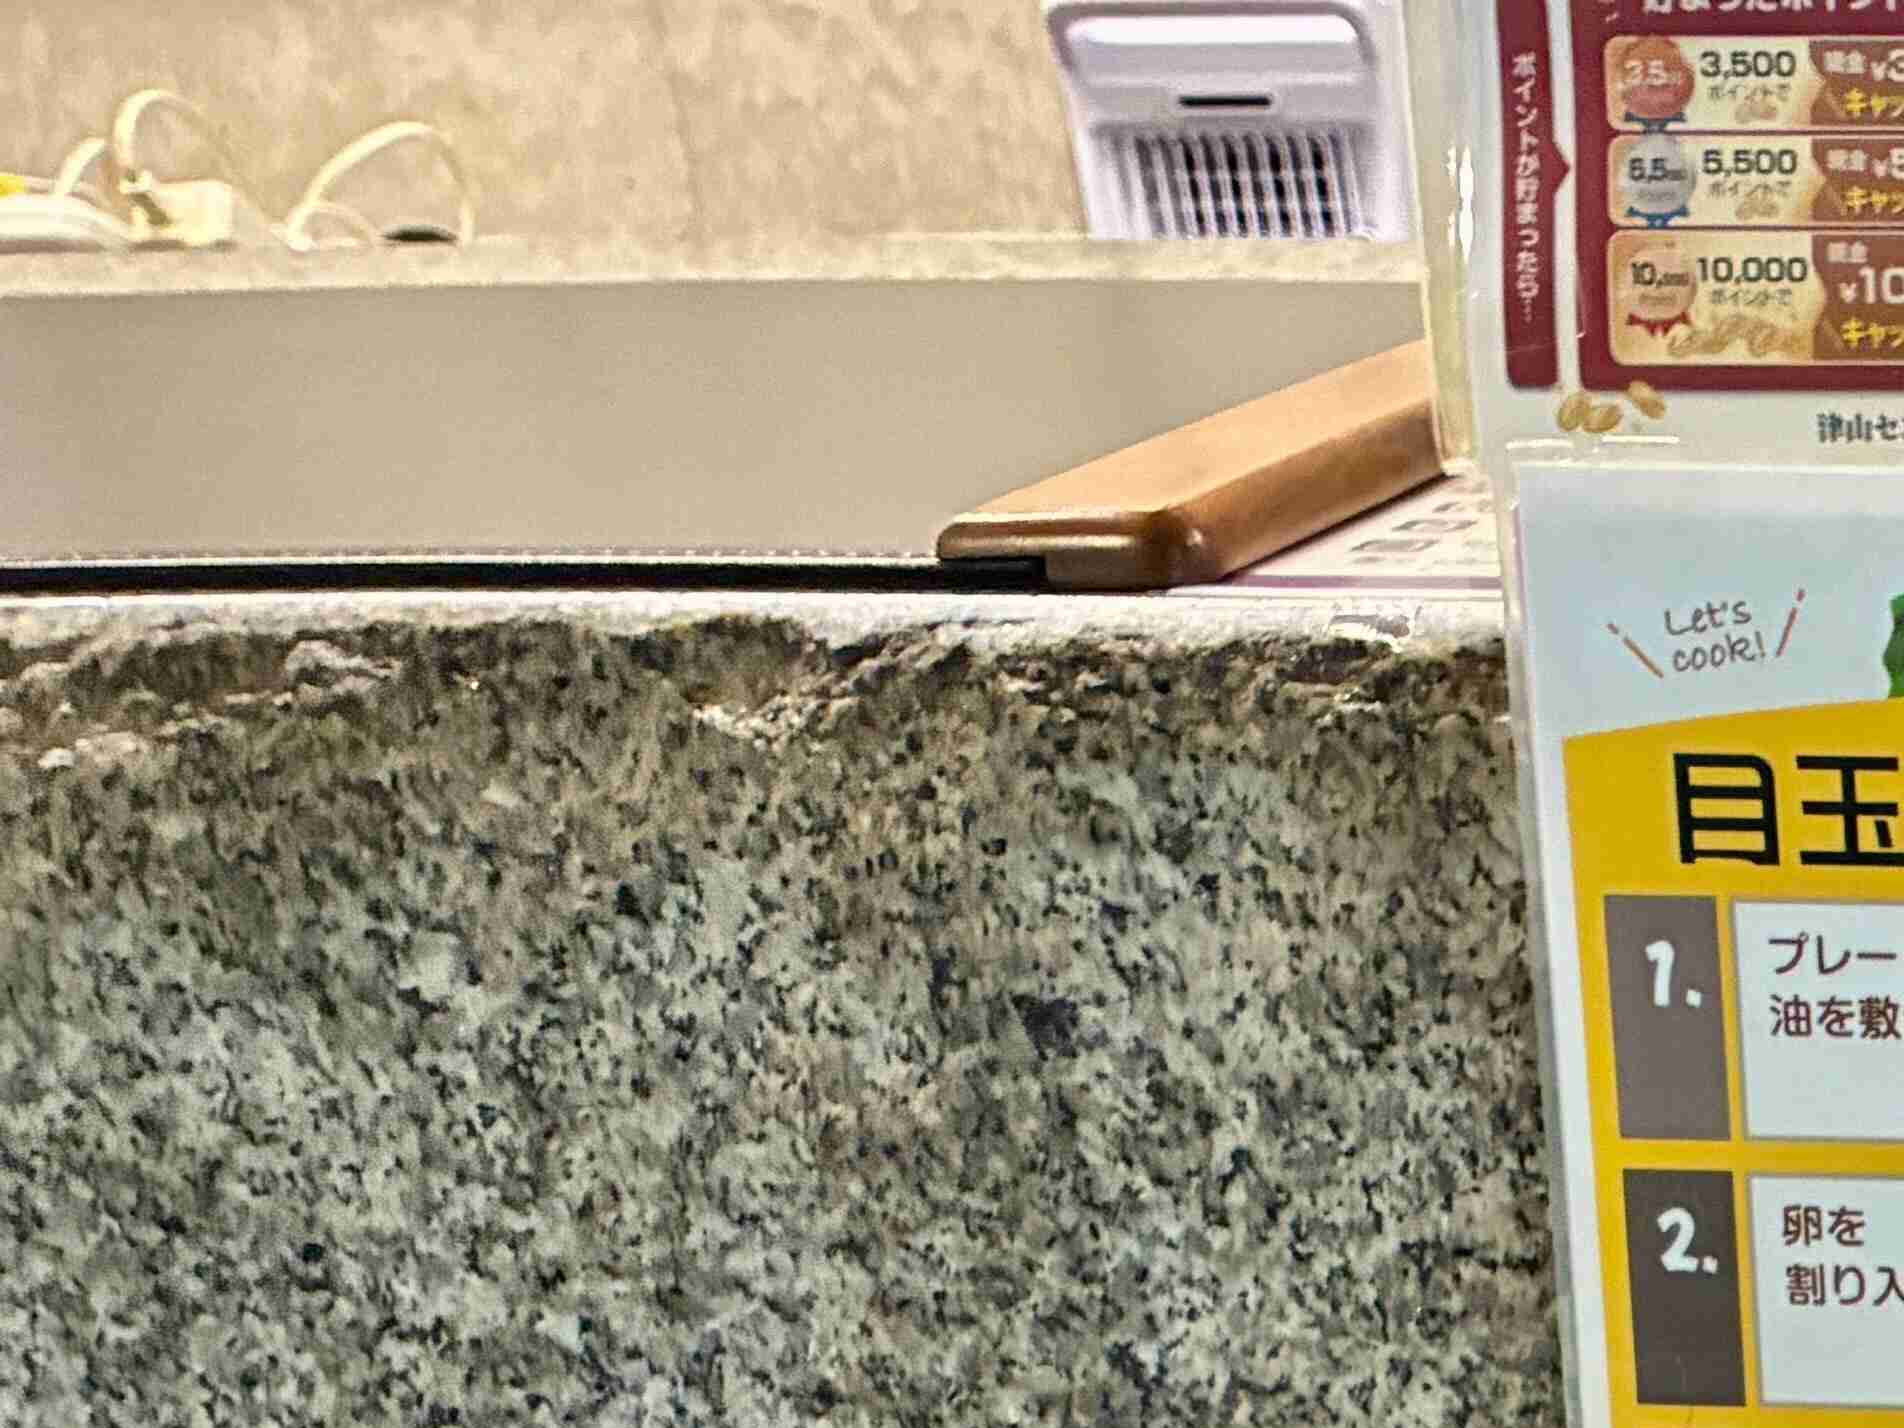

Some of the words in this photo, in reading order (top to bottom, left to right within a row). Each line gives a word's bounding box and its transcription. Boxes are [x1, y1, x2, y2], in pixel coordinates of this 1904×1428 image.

[1699, 50, 1797, 80] 3,500
[1702, 148, 1799, 178] 5,500
[1697, 256, 1808, 284] 10,000
[1663, 600, 1753, 636] Let's
[1671, 630, 1766, 673] cook!
[1644, 940, 1703, 1008] 1.
[1656, 1206, 1720, 1276] 2.
[1781, 1204, 1867, 1248] 卵を
